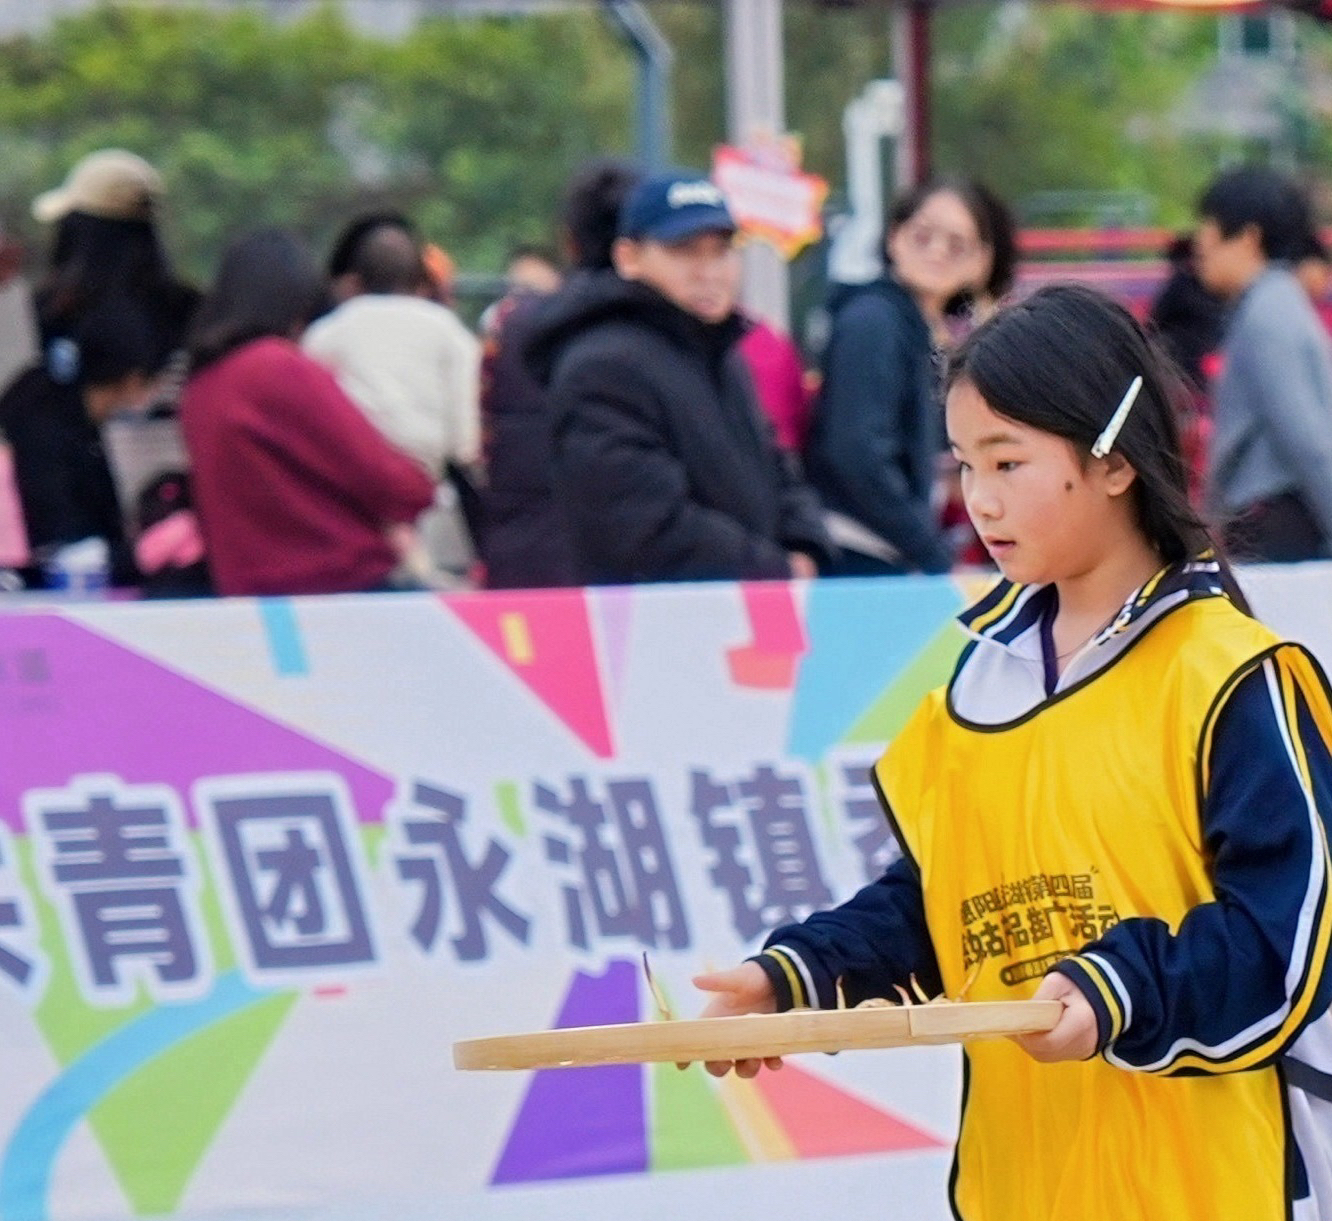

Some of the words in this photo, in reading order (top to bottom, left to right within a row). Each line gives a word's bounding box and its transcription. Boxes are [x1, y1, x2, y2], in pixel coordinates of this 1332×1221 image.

[0, 766, 900, 987] 青团永湖镇
